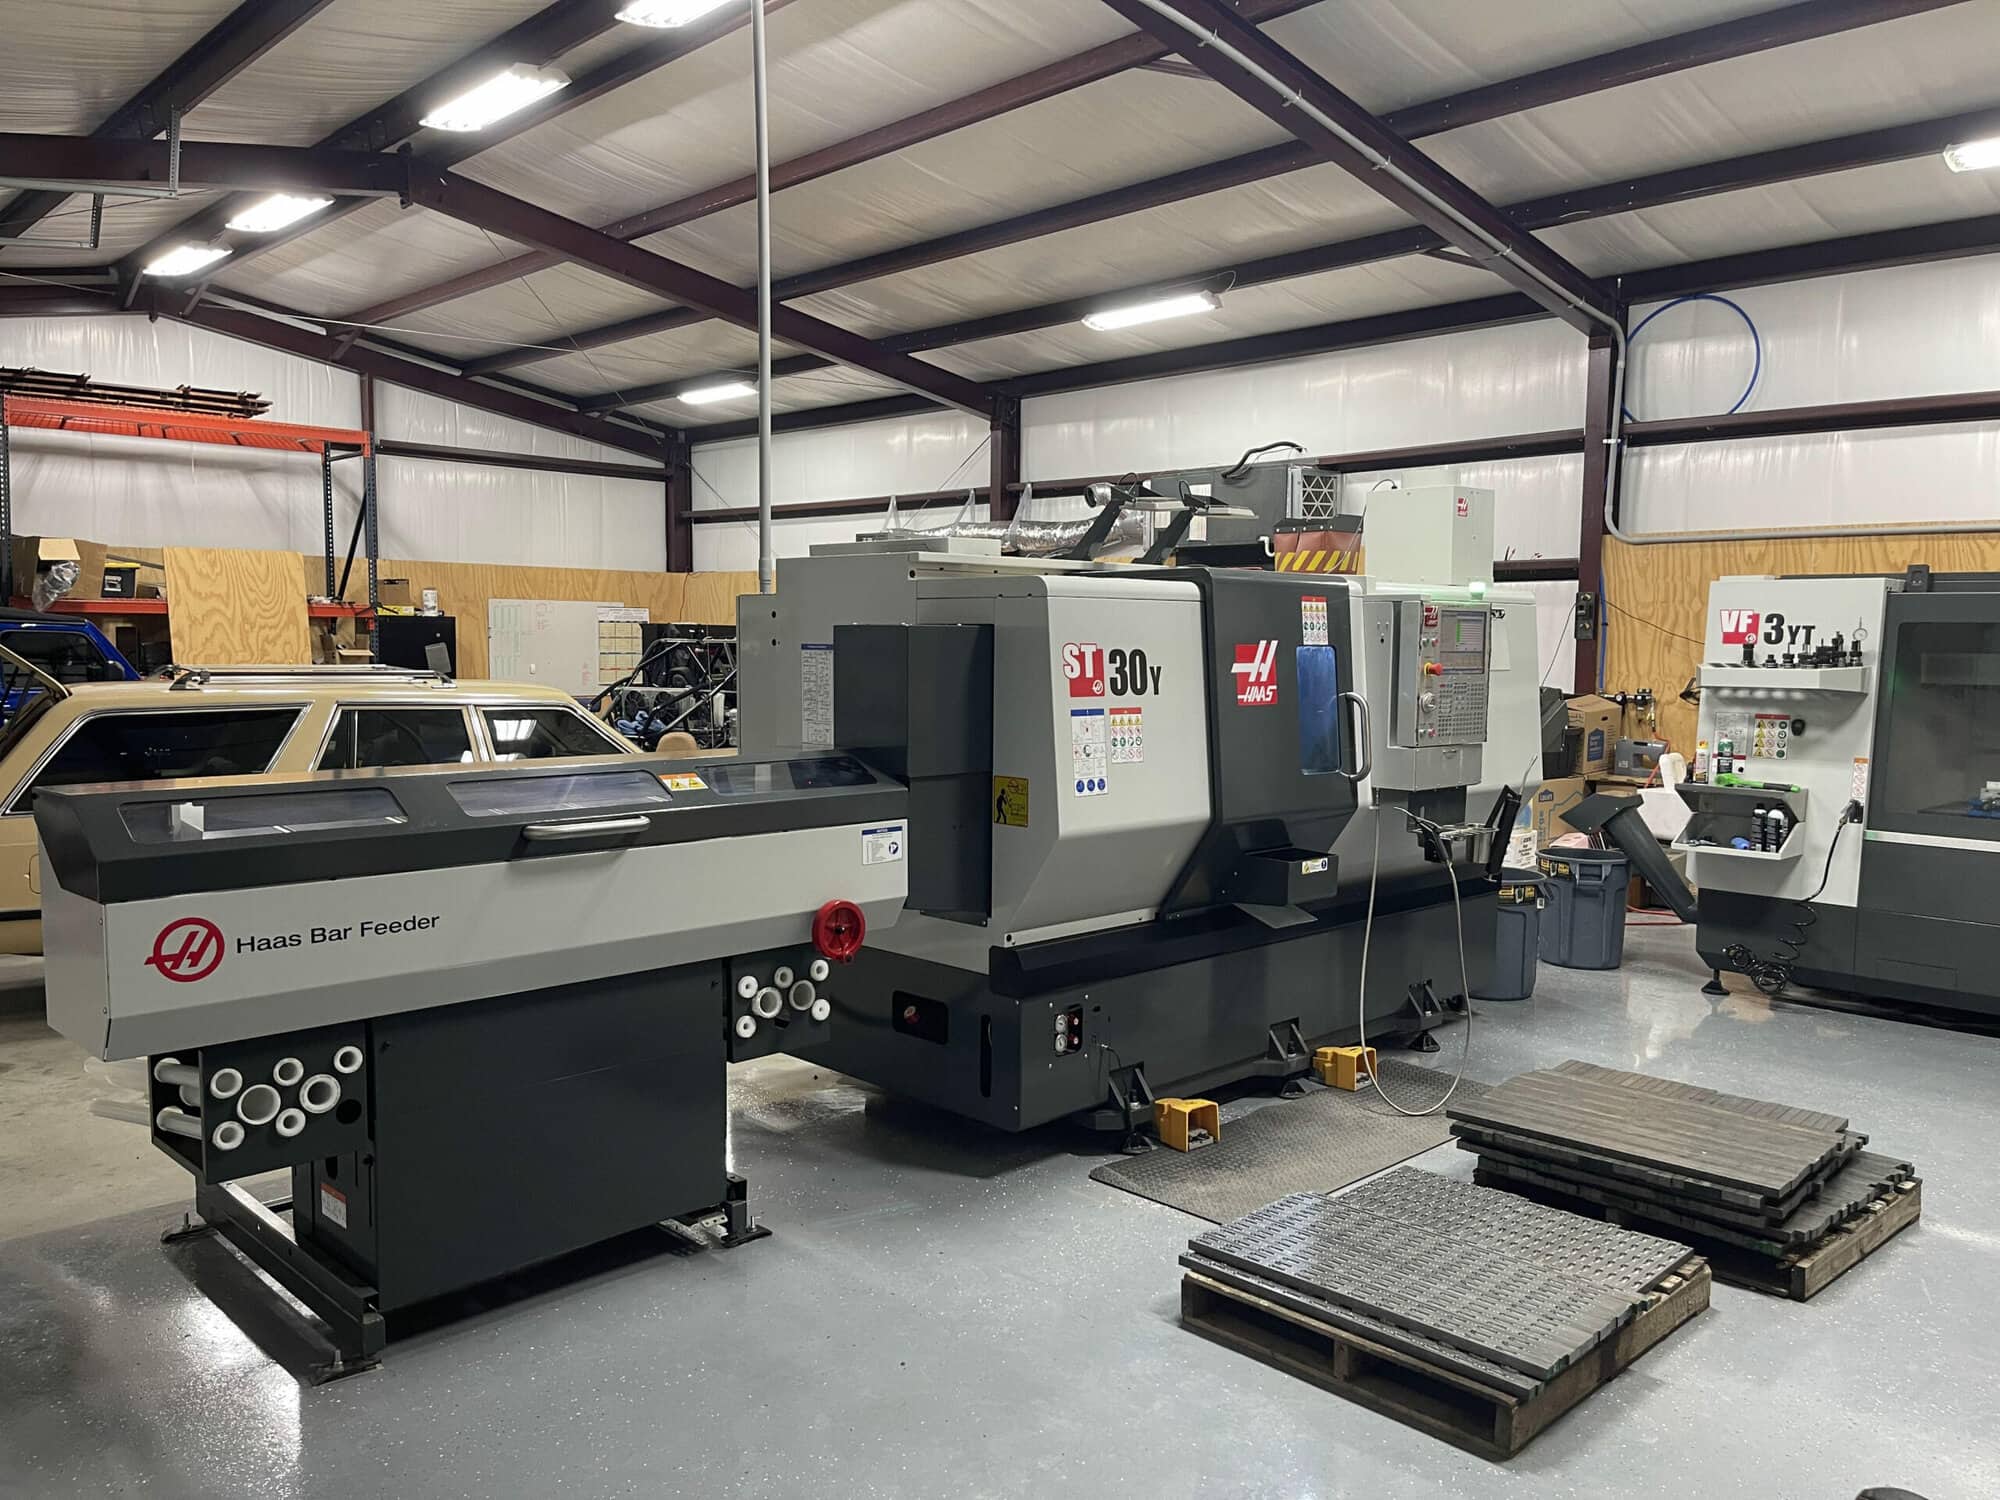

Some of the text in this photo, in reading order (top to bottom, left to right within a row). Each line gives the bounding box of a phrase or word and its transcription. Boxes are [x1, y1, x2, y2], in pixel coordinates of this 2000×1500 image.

[1720, 609, 1754, 633] VF
[1062, 642, 1097, 680] ST
[1237, 685, 1278, 702] HAAS
[236, 932, 302, 953] Haas
[310, 926, 353, 944] Bar
[360, 915, 441, 938] Feeder
